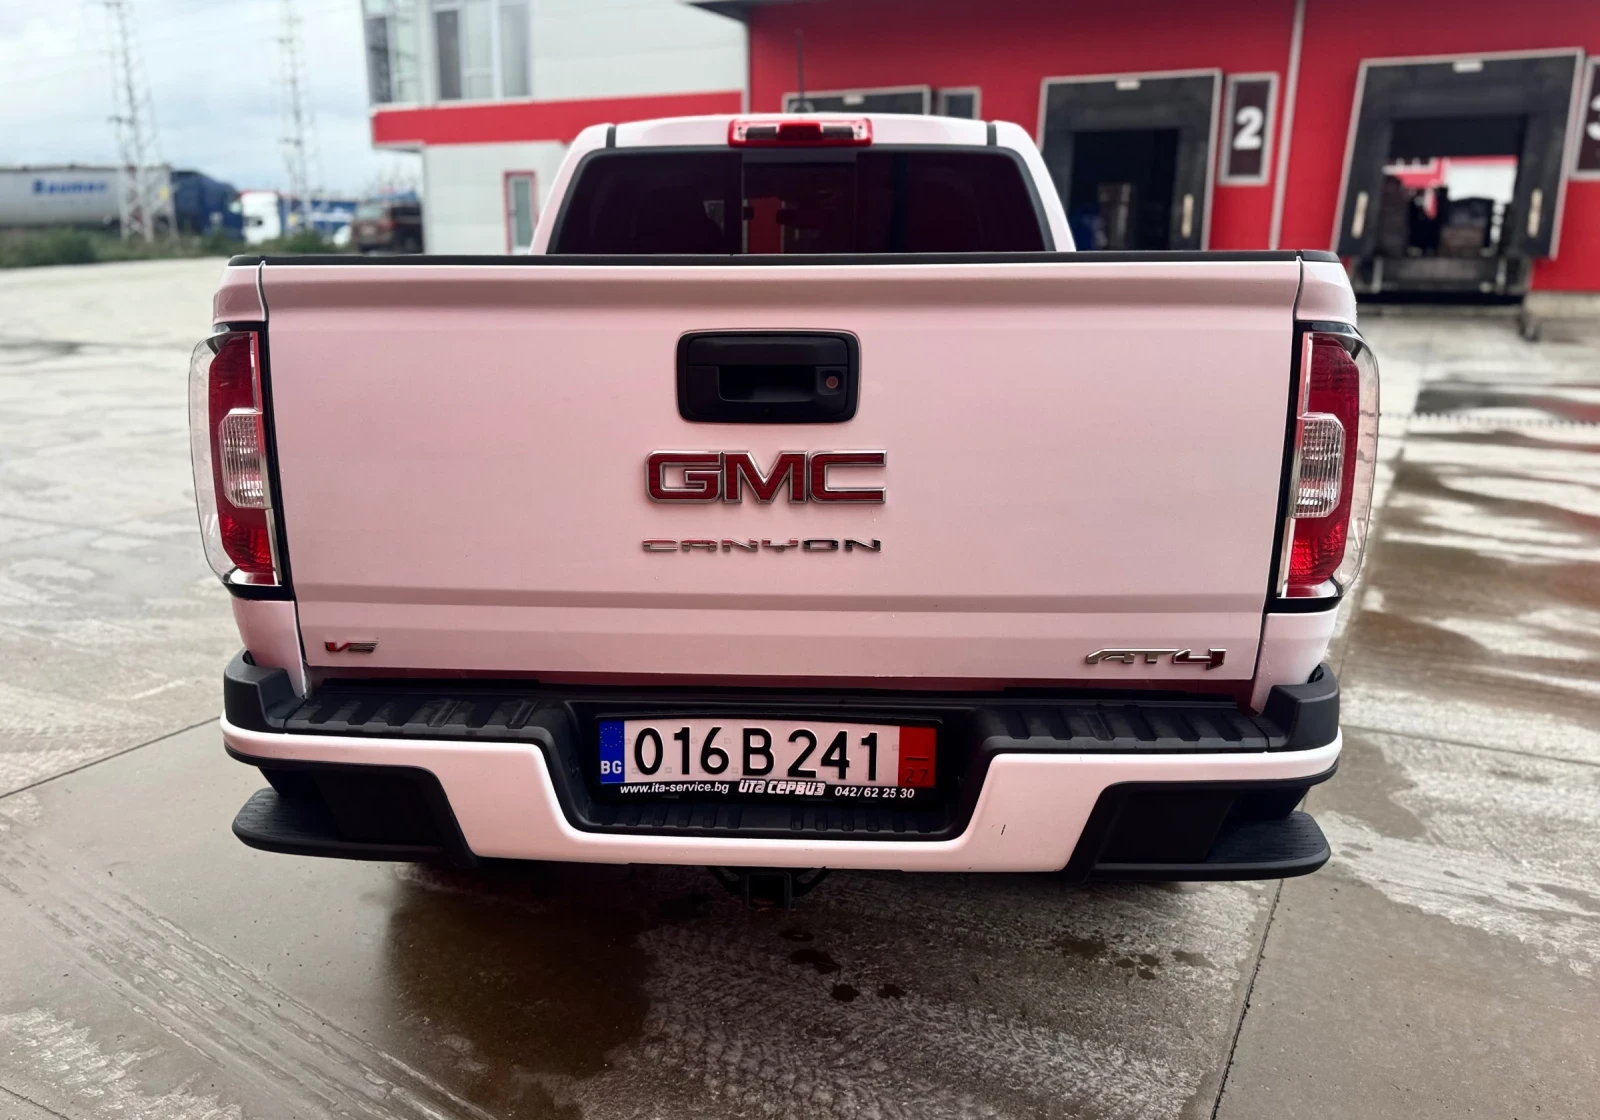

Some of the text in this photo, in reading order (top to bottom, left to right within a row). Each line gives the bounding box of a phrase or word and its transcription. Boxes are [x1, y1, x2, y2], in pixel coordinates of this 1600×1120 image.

[1233, 106, 1264, 151] 2
[645, 450, 887, 504] GMC
[642, 538, 882, 553] CANYON
[1086, 648, 1227, 671] AT4
[600, 760, 622, 775] BG
[904, 767, 929, 784] 27
[619, 782, 729, 794] www.ita-service.bg
[882, 787, 897, 798] 25
[899, 788, 915, 799] 30
